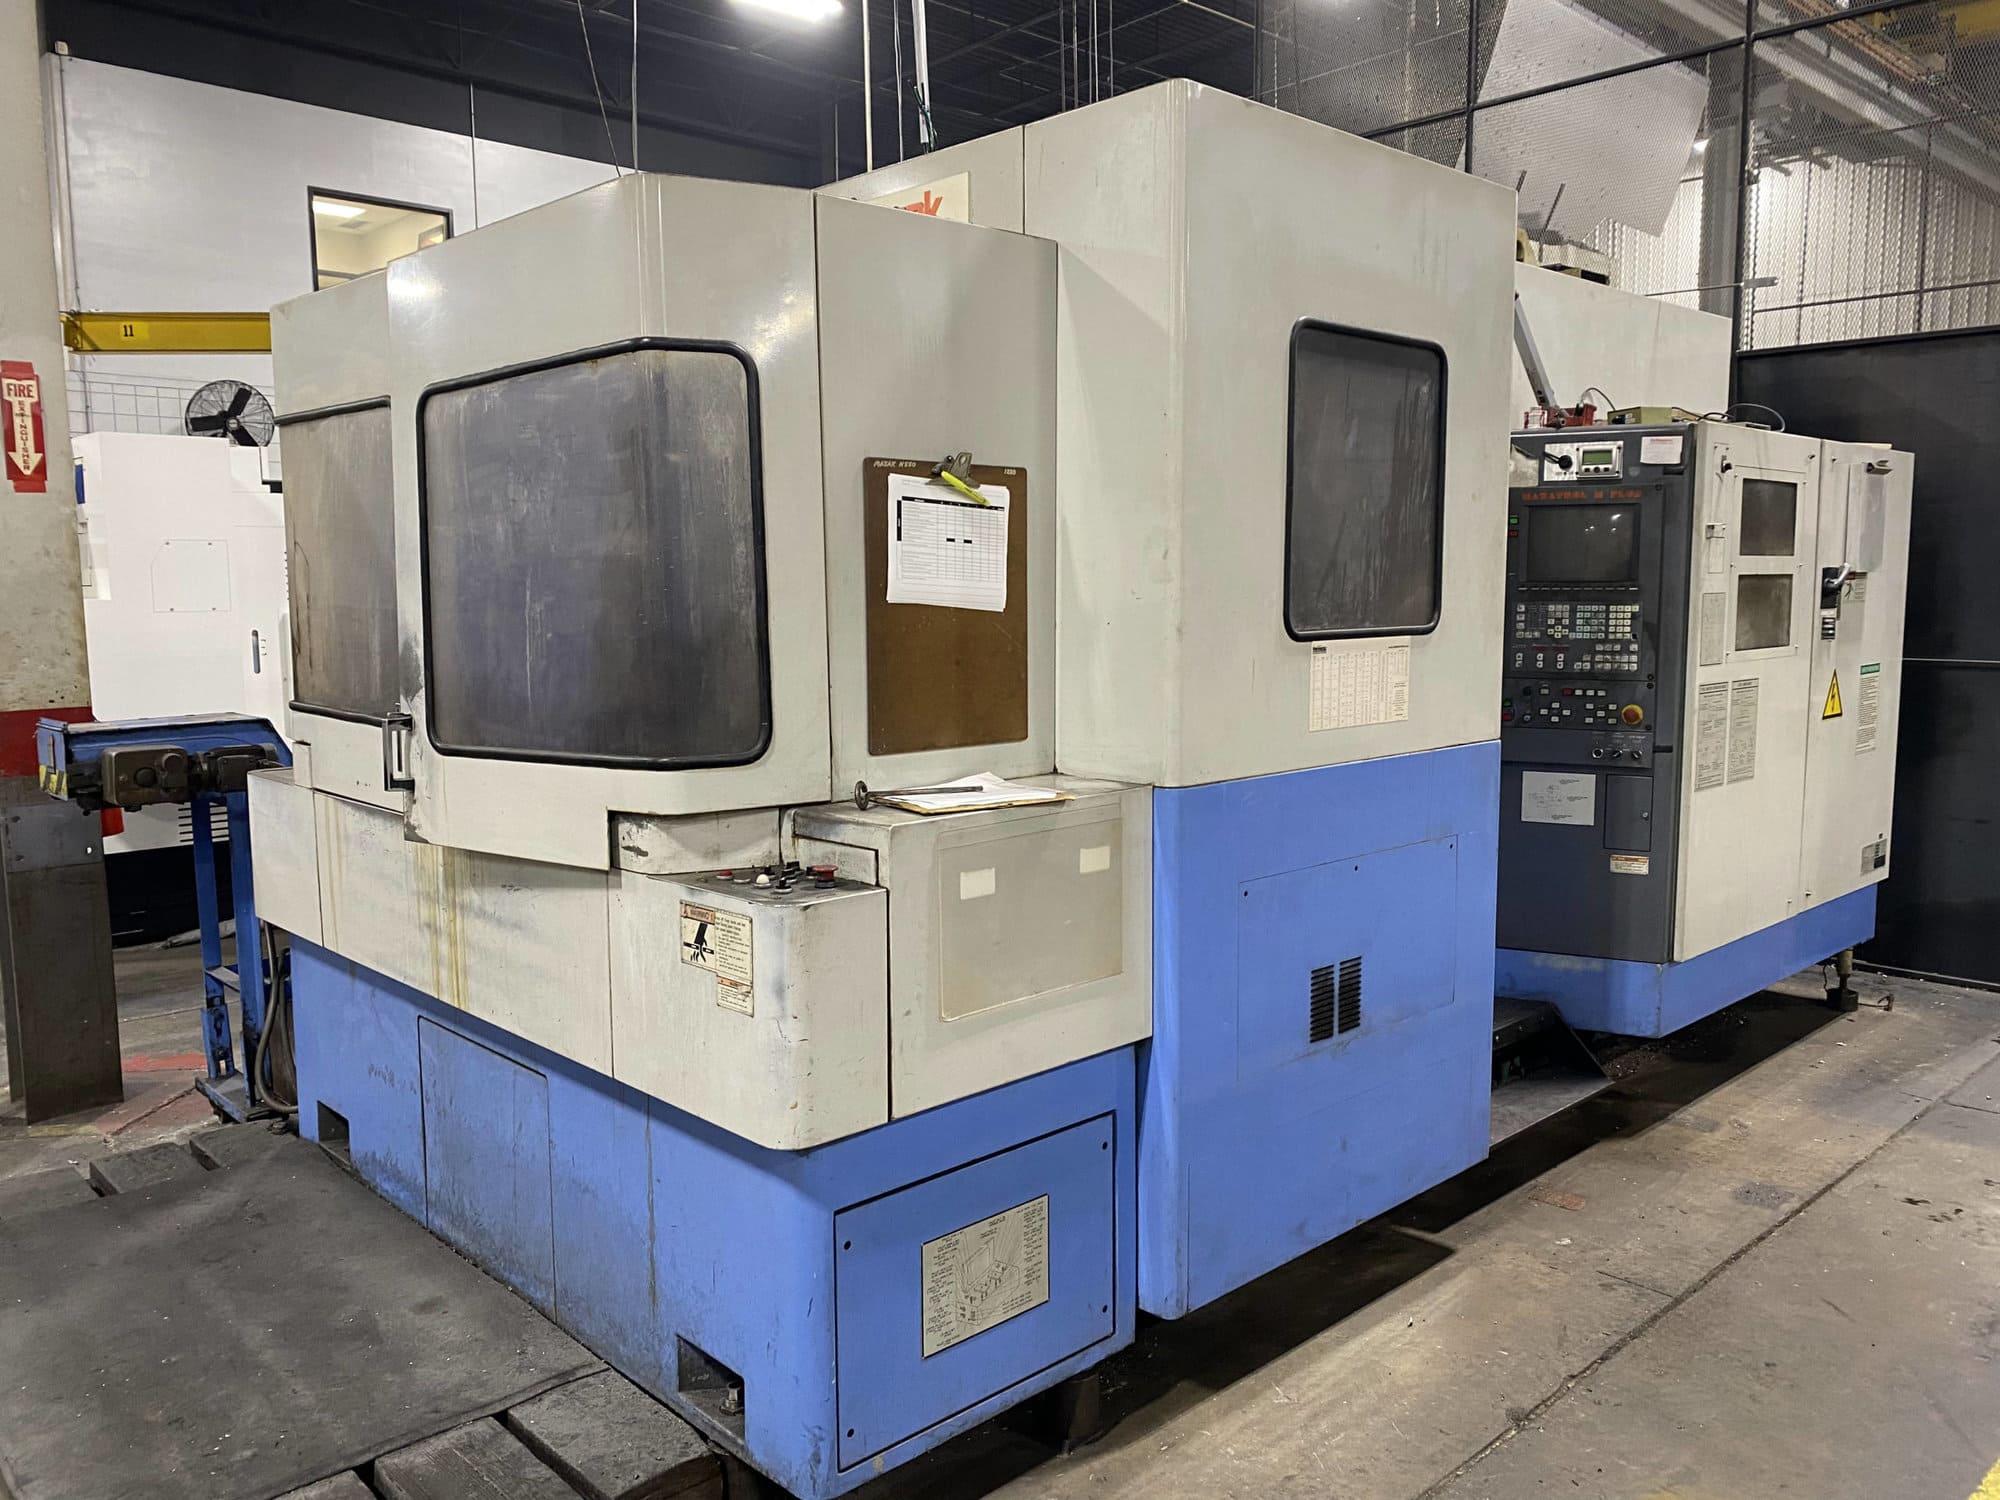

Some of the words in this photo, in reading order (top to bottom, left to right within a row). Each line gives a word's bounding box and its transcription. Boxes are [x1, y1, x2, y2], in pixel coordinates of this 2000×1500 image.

[123, 324, 134, 337] 11
[6, 382, 35, 398] FIRE
[18, 400, 30, 471] EXTINGUISHER
